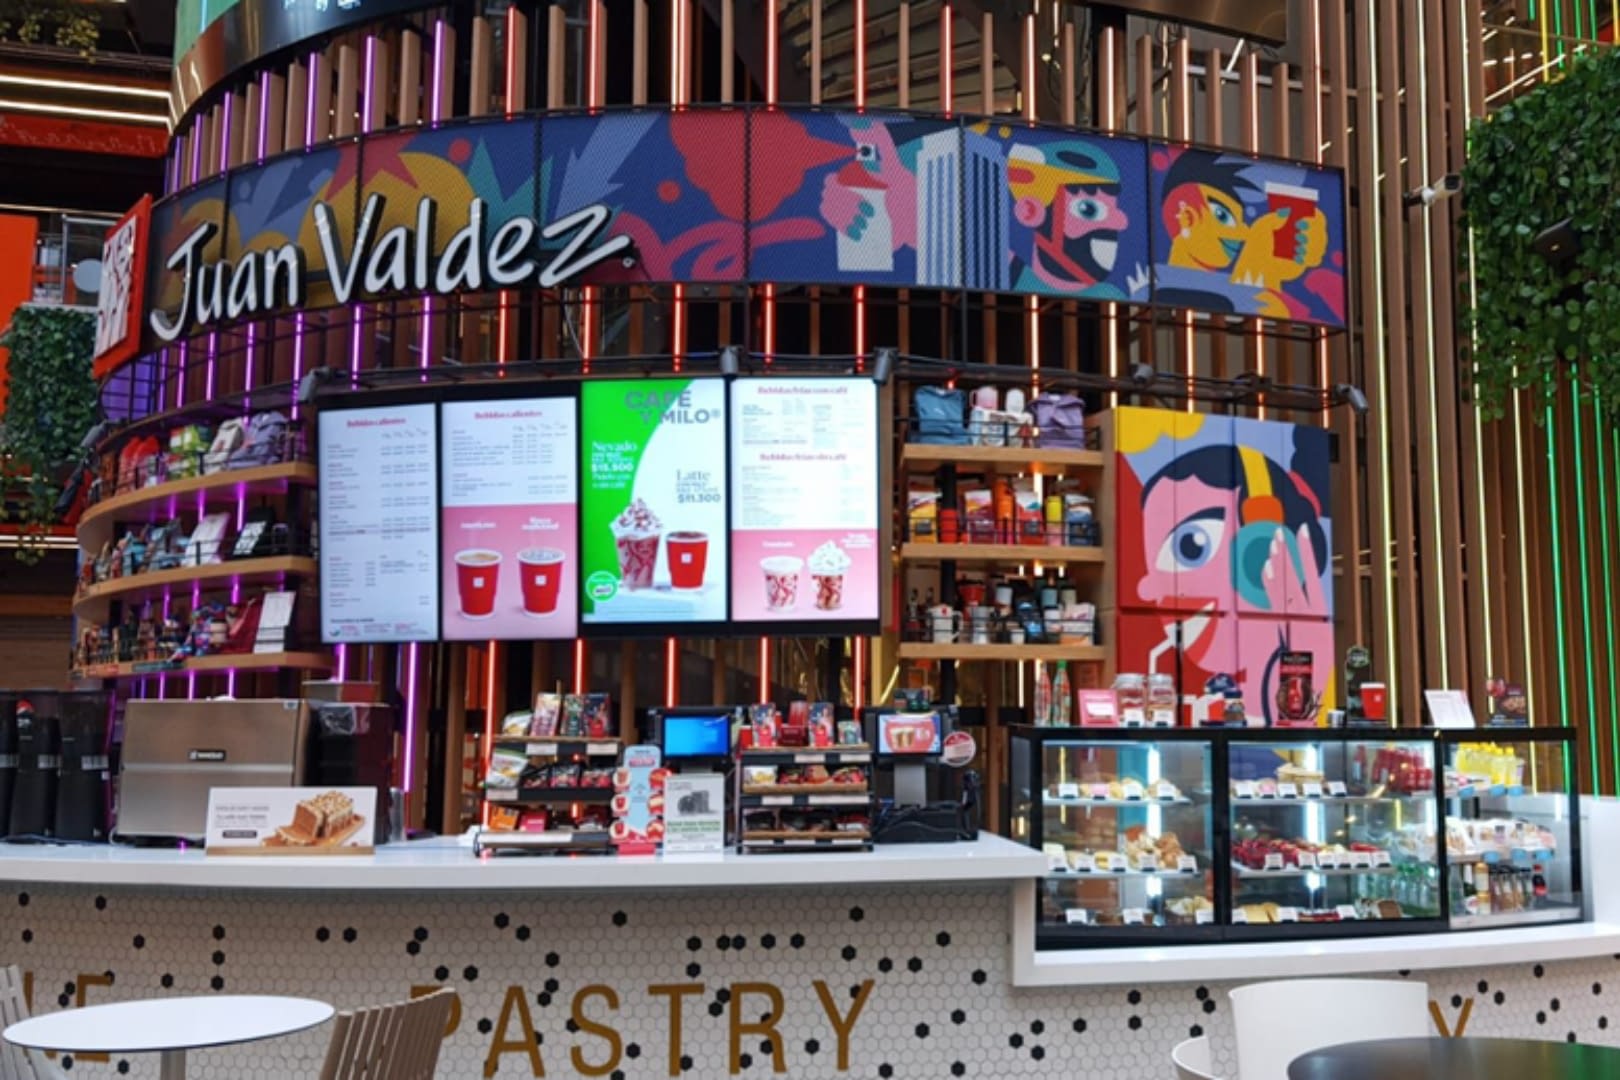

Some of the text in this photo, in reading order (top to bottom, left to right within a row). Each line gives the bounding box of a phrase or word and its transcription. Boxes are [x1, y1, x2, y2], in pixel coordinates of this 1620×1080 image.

[150, 193, 631, 340] Juan Valdez
[641, 409, 652, 425] Y
